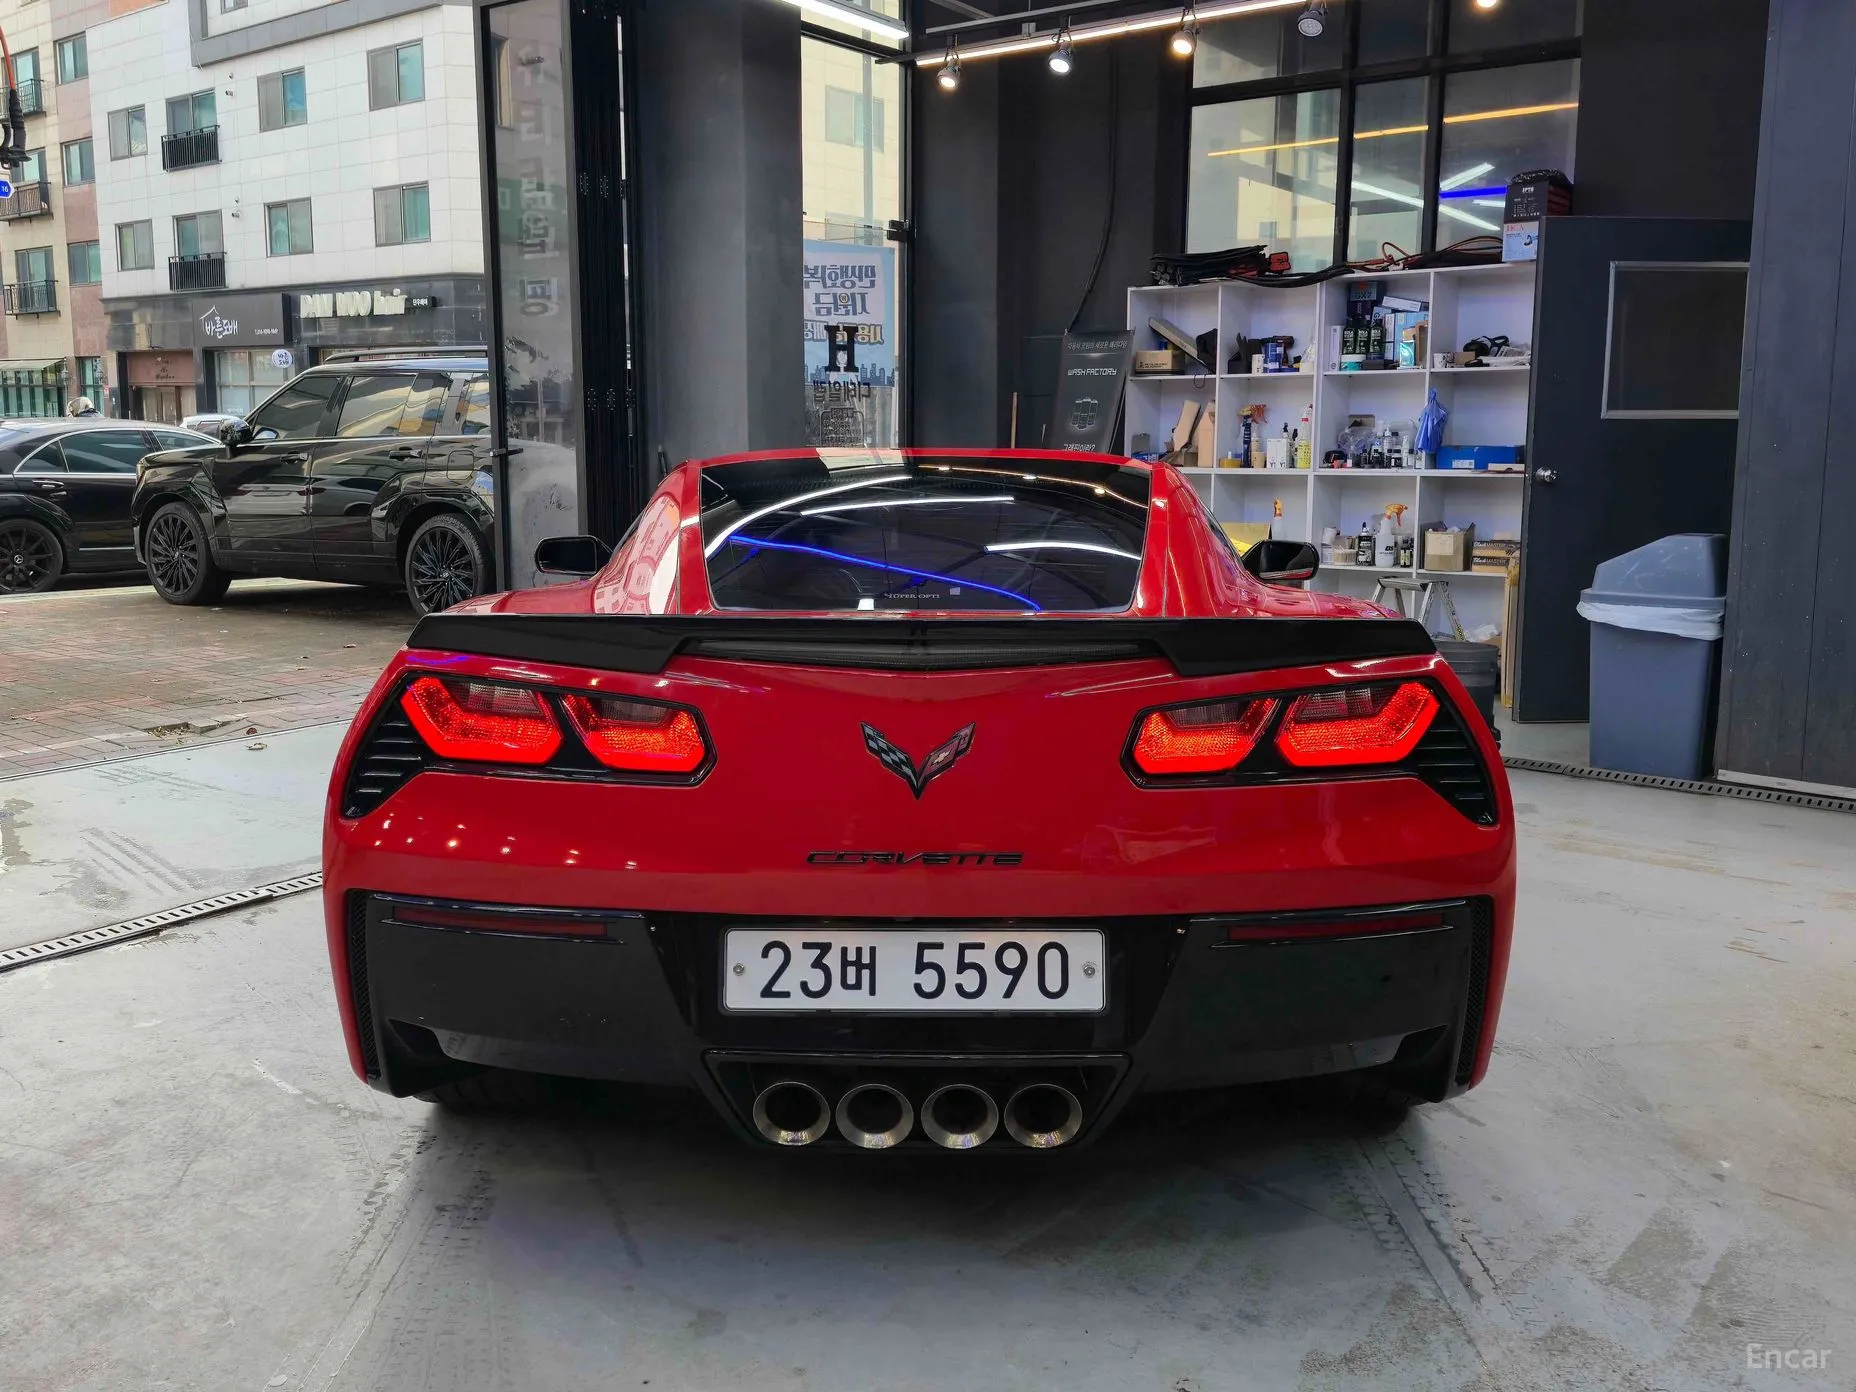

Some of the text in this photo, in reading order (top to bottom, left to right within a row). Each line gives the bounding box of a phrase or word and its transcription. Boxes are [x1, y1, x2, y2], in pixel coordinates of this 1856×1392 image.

[205, 316, 239, 339] 바른도배
[824, 325, 859, 372] H
[806, 851, 1024, 865] CORVETTE
[760, 940, 1069, 1000] 23버 5590
